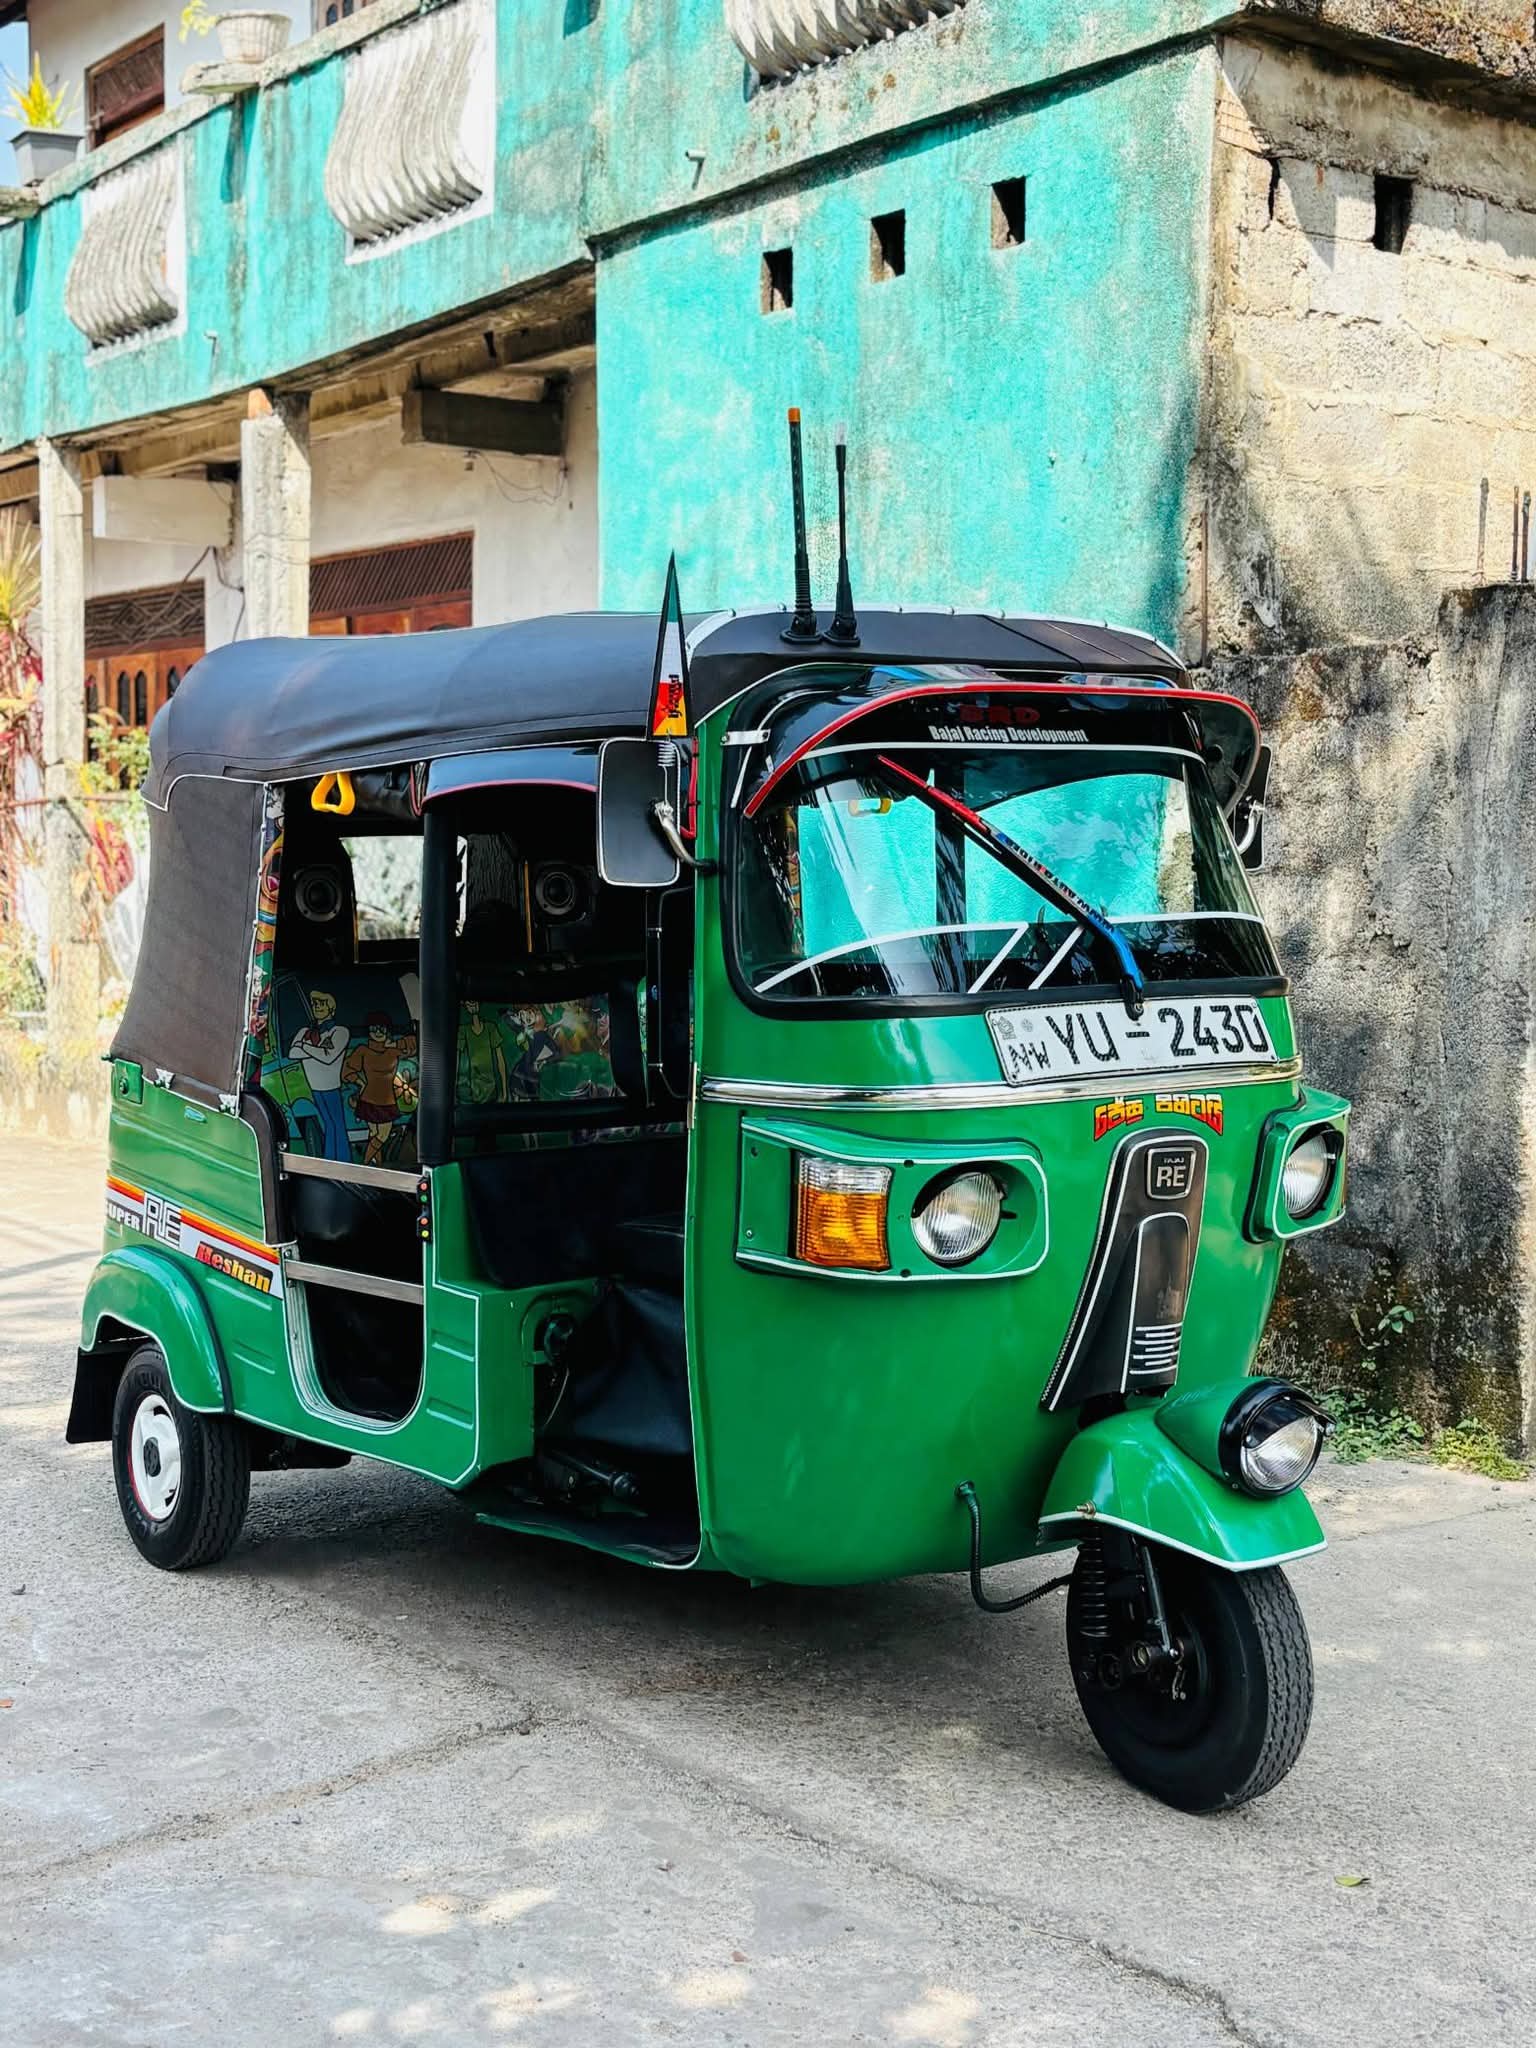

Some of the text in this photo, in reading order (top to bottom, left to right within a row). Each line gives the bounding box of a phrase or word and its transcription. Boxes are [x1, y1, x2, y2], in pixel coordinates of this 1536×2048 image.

[928, 725, 1090, 743] Bajaj Racing Development
[1156, 1165, 1187, 1187] RE
[142, 1191, 182, 1249] RE
